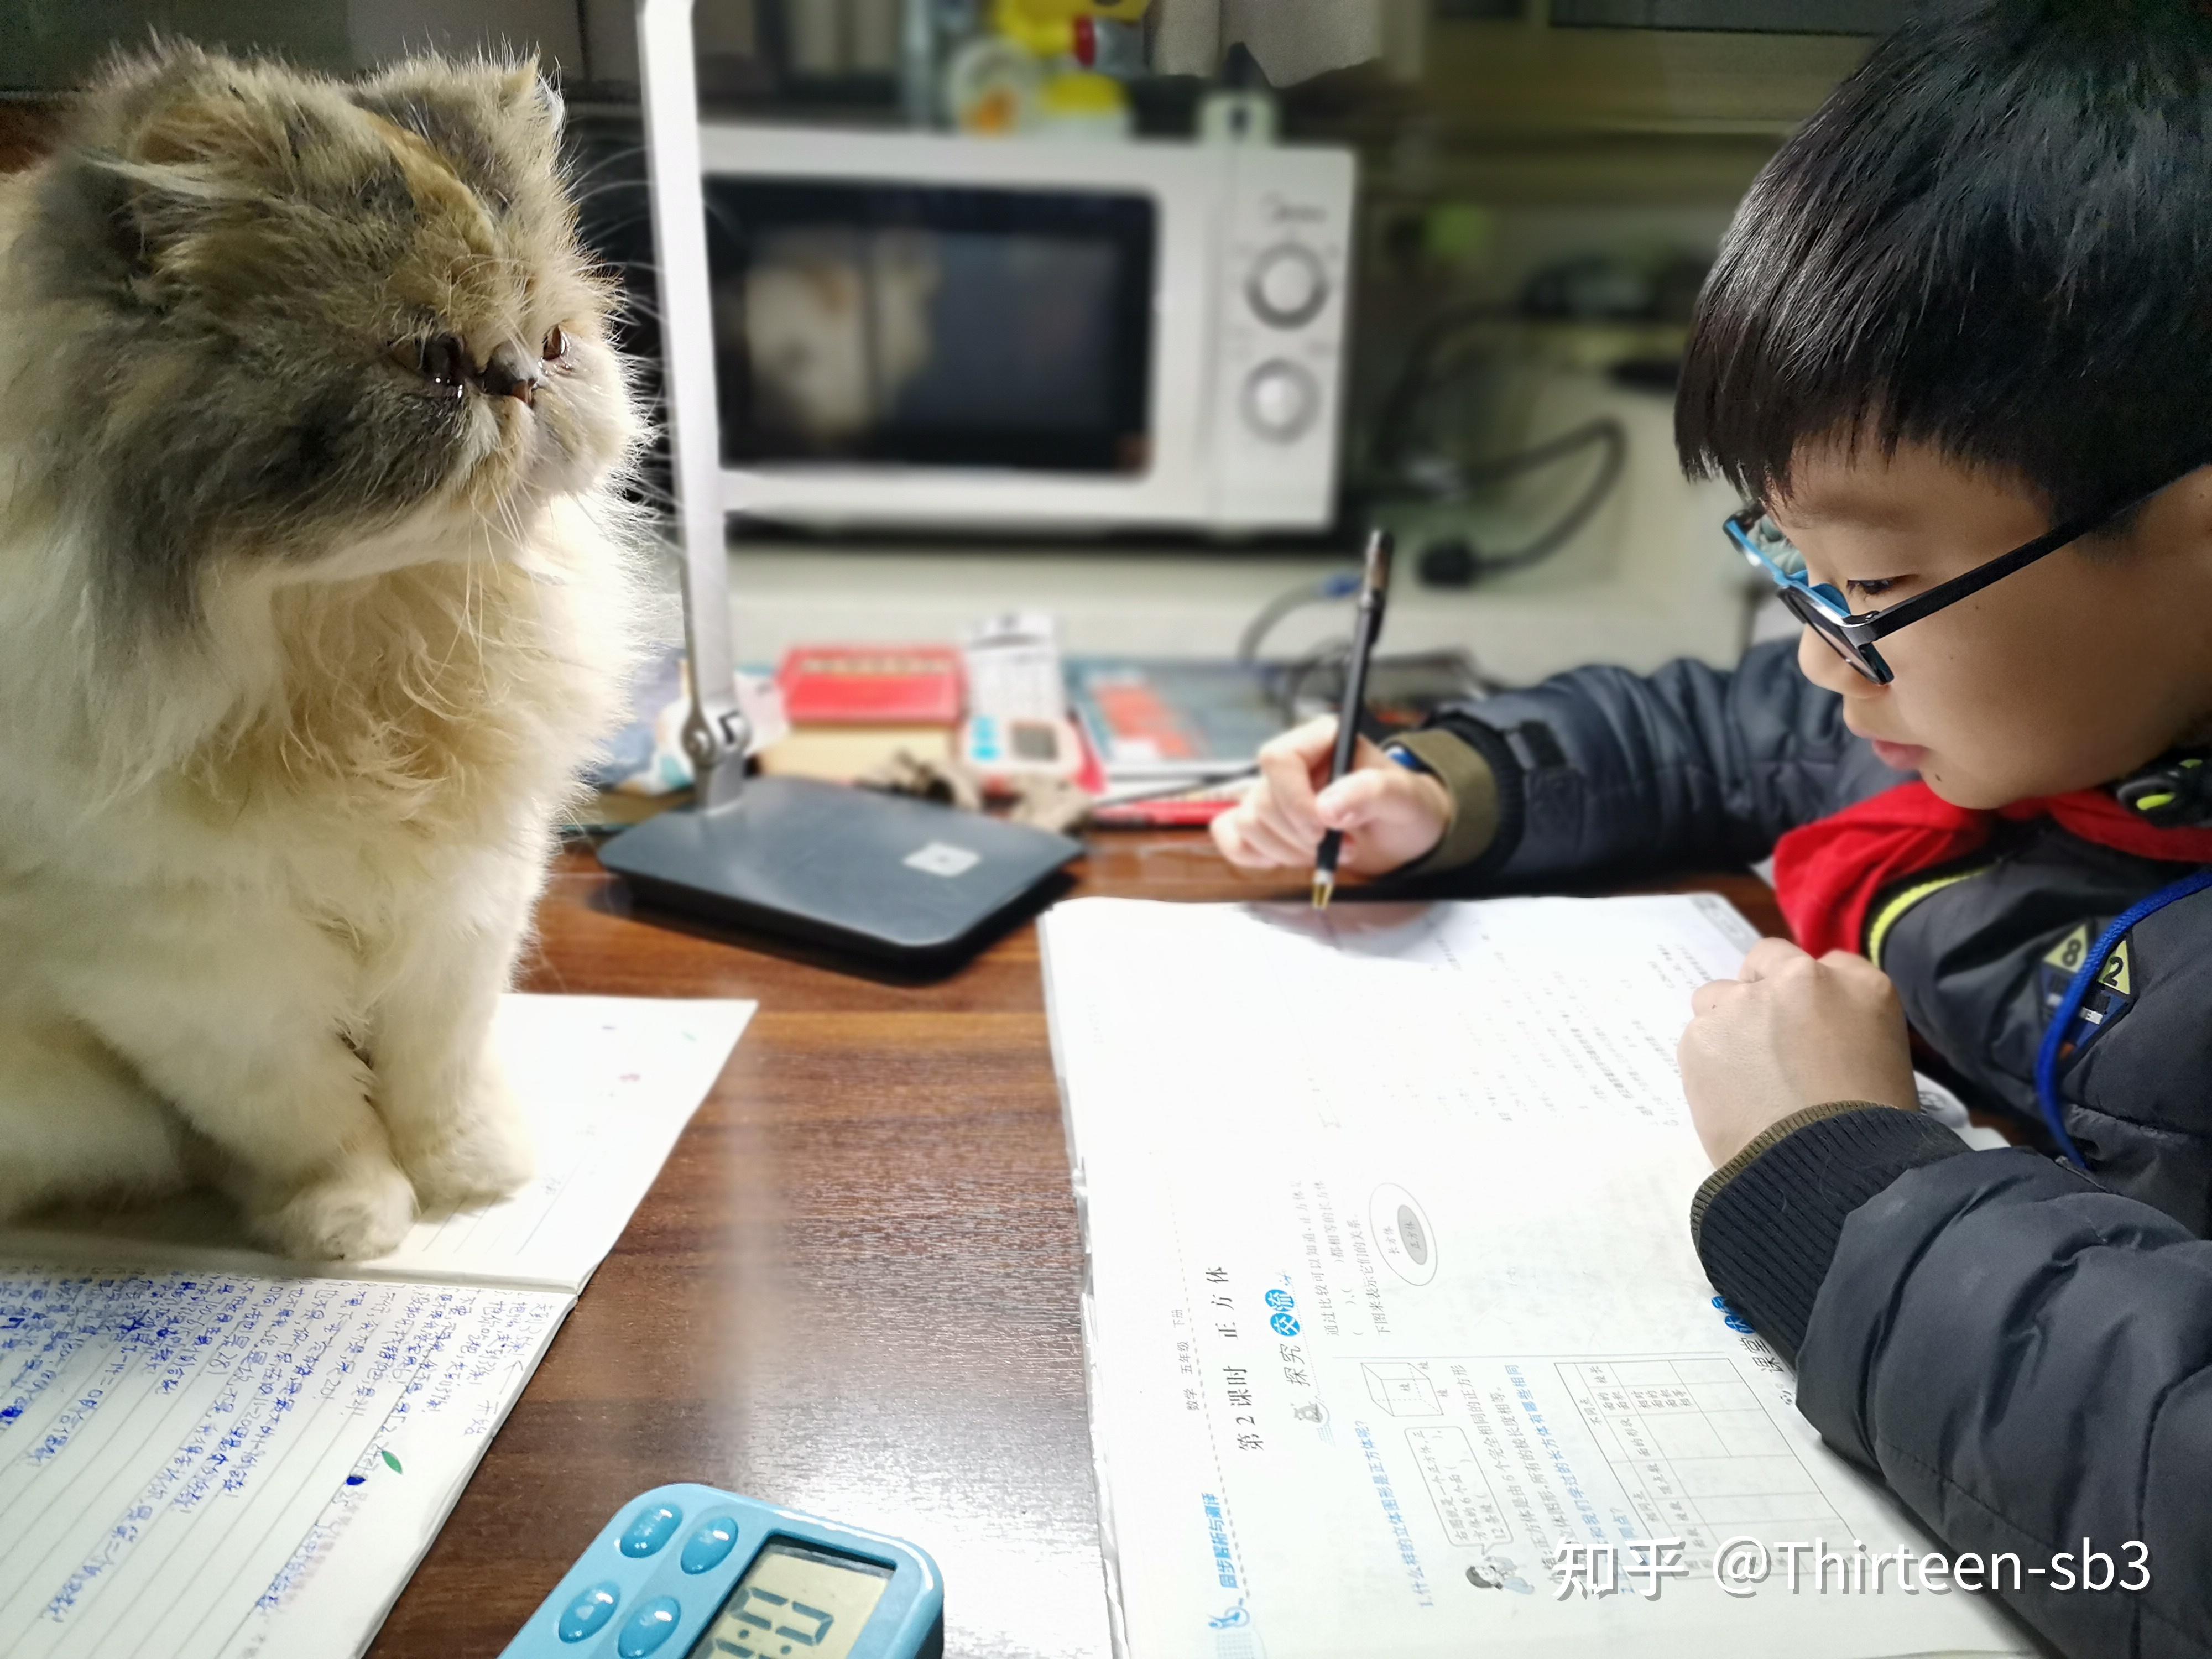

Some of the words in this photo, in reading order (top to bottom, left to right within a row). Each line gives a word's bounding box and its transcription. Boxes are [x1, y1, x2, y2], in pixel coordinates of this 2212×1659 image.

[1205, 1266, 1238, 1340] 正方体
[1172, 1309, 1185, 1328] 下册
[1177, 1340, 1193, 1375] 五年级
[1183, 1388, 1199, 1411] 数学
